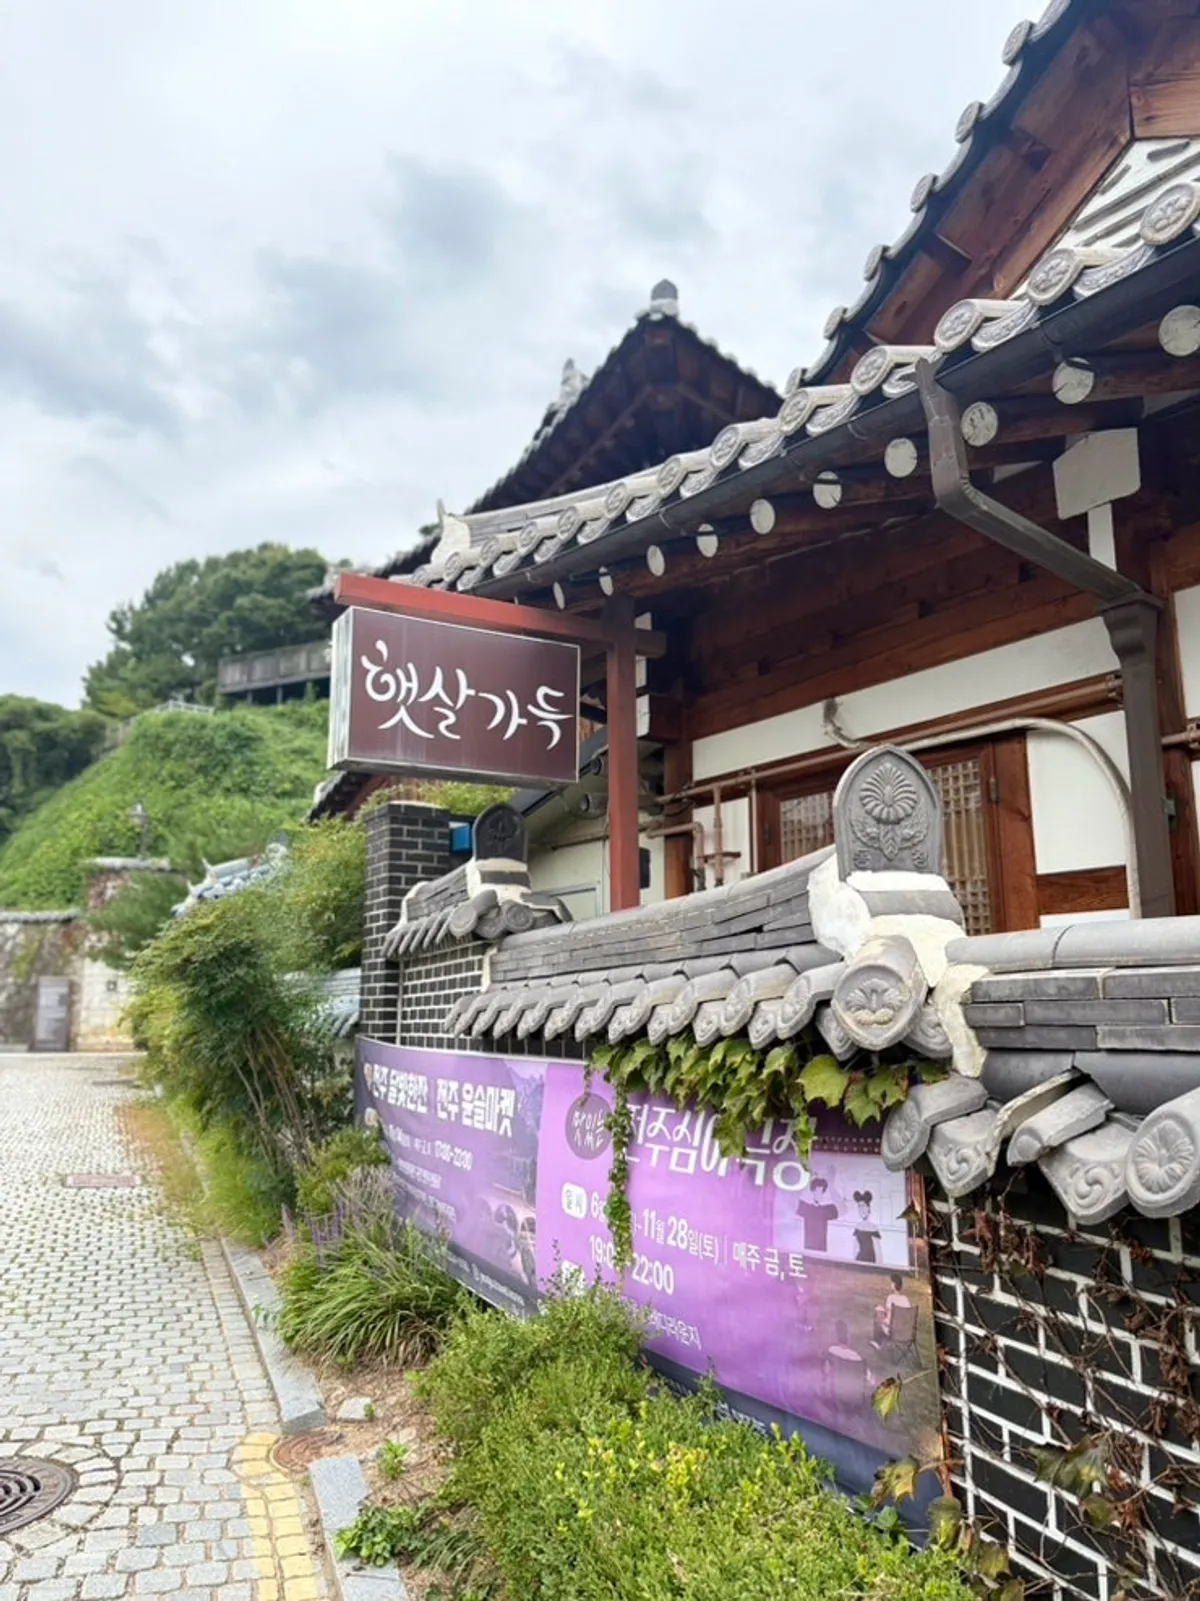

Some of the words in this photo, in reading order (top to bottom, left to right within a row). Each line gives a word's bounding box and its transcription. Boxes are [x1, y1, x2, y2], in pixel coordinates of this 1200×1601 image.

[361, 639, 574, 750] 햇살가득
[436, 1078, 459, 1121] 전주
[666, 1216, 720, 1264] 28일(토)
